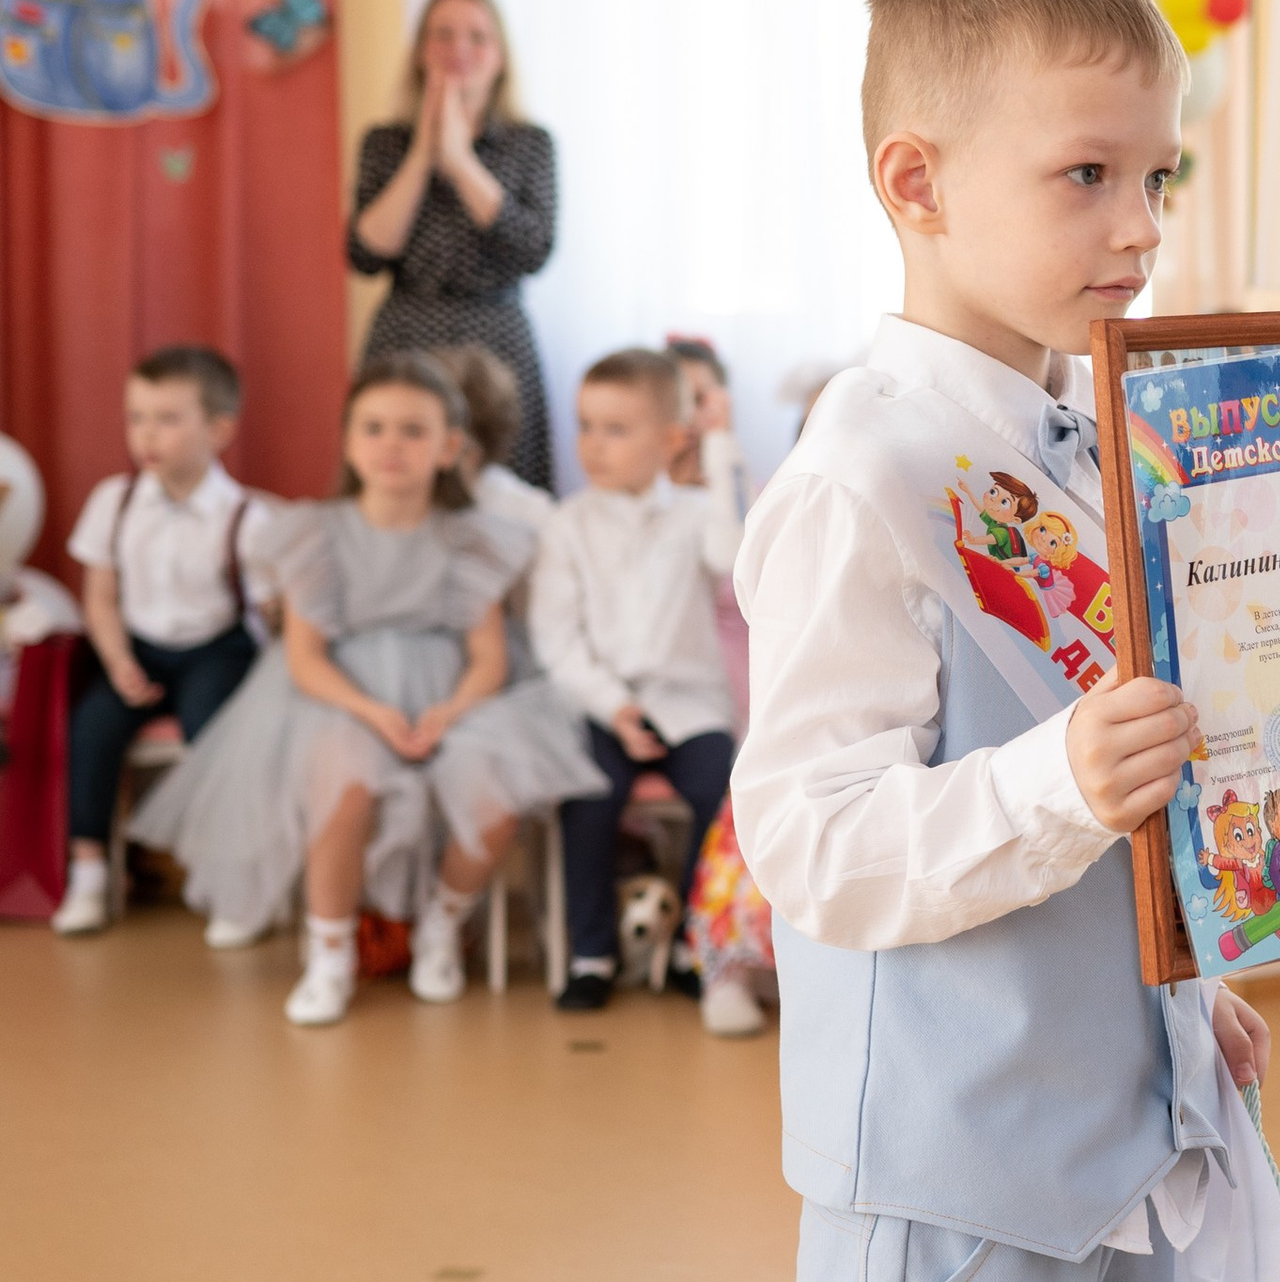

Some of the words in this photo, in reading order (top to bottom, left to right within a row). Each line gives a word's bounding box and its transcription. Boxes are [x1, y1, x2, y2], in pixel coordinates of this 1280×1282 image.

[1254, 611, 1260, 620] В
[1255, 623, 1280, 634] Смеха,
[1238, 641, 1258, 652] Ждет
[1259, 651, 1280, 663] пусть
[1205, 725, 1254, 743] Заведующий
[1206, 741, 1256, 758] Воспитатели
[1210, 765, 1277, 785] Учитель-логопед
